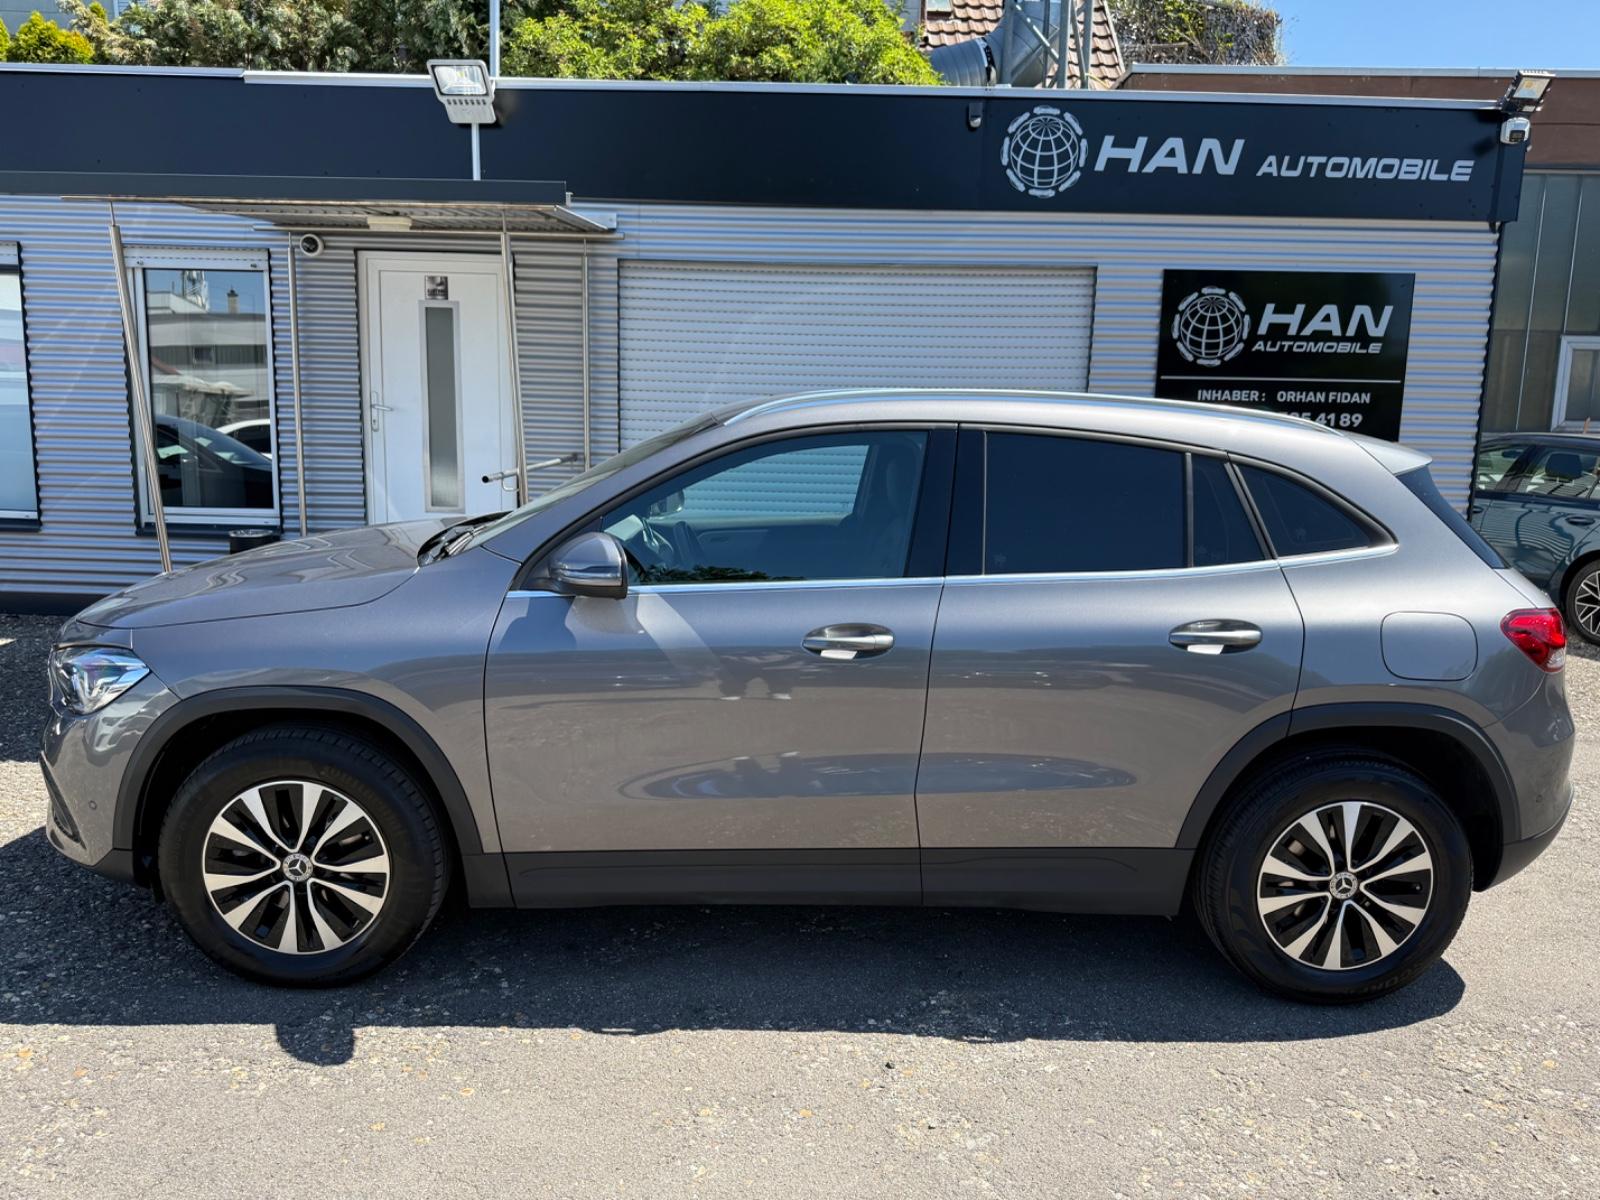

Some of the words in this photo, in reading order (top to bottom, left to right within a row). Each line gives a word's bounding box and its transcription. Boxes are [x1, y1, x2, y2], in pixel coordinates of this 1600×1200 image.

[1094, 135, 1245, 176] HAN
[1256, 155, 1475, 182] AUTOMOBILE
[1256, 303, 1394, 338] HAN
[1251, 340, 1382, 354] AUTOMOBILE
[1276, 390, 1326, 403] ORHAN
[1328, 391, 1371, 404] FIDAN
